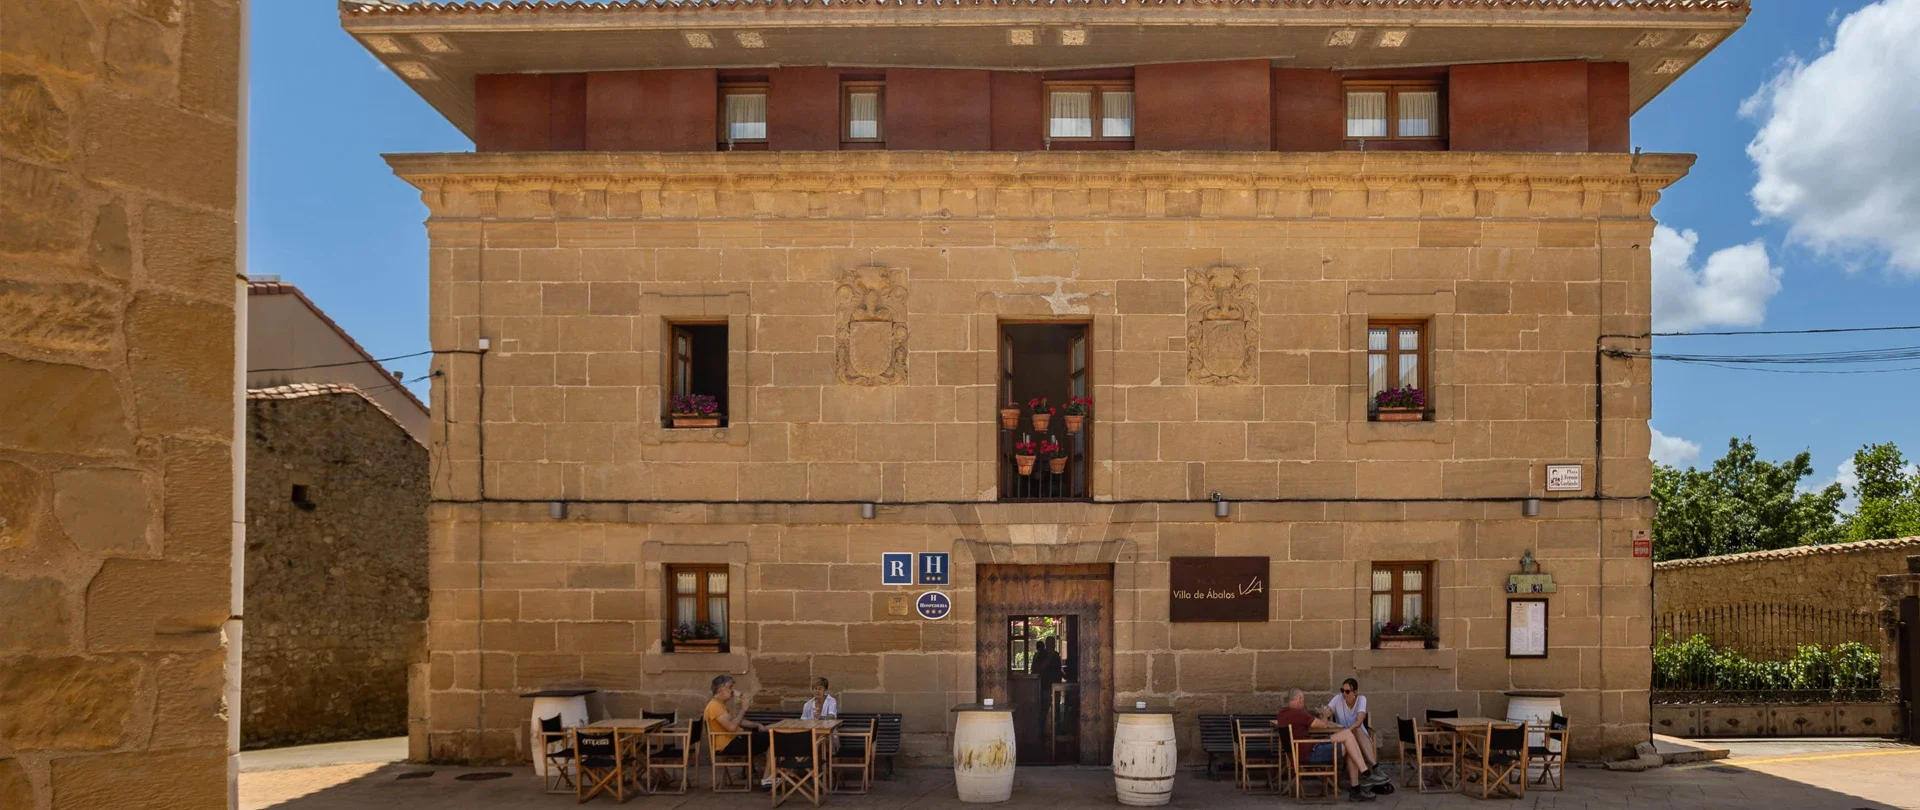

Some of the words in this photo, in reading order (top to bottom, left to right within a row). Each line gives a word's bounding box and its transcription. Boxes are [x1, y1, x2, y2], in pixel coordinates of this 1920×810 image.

[890, 560, 904, 576] R
[925, 556, 942, 573] H
[1174, 590, 1191, 598] Villa
[1194, 590, 1204, 598] de
[1206, 588, 1235, 598] Ábalos
